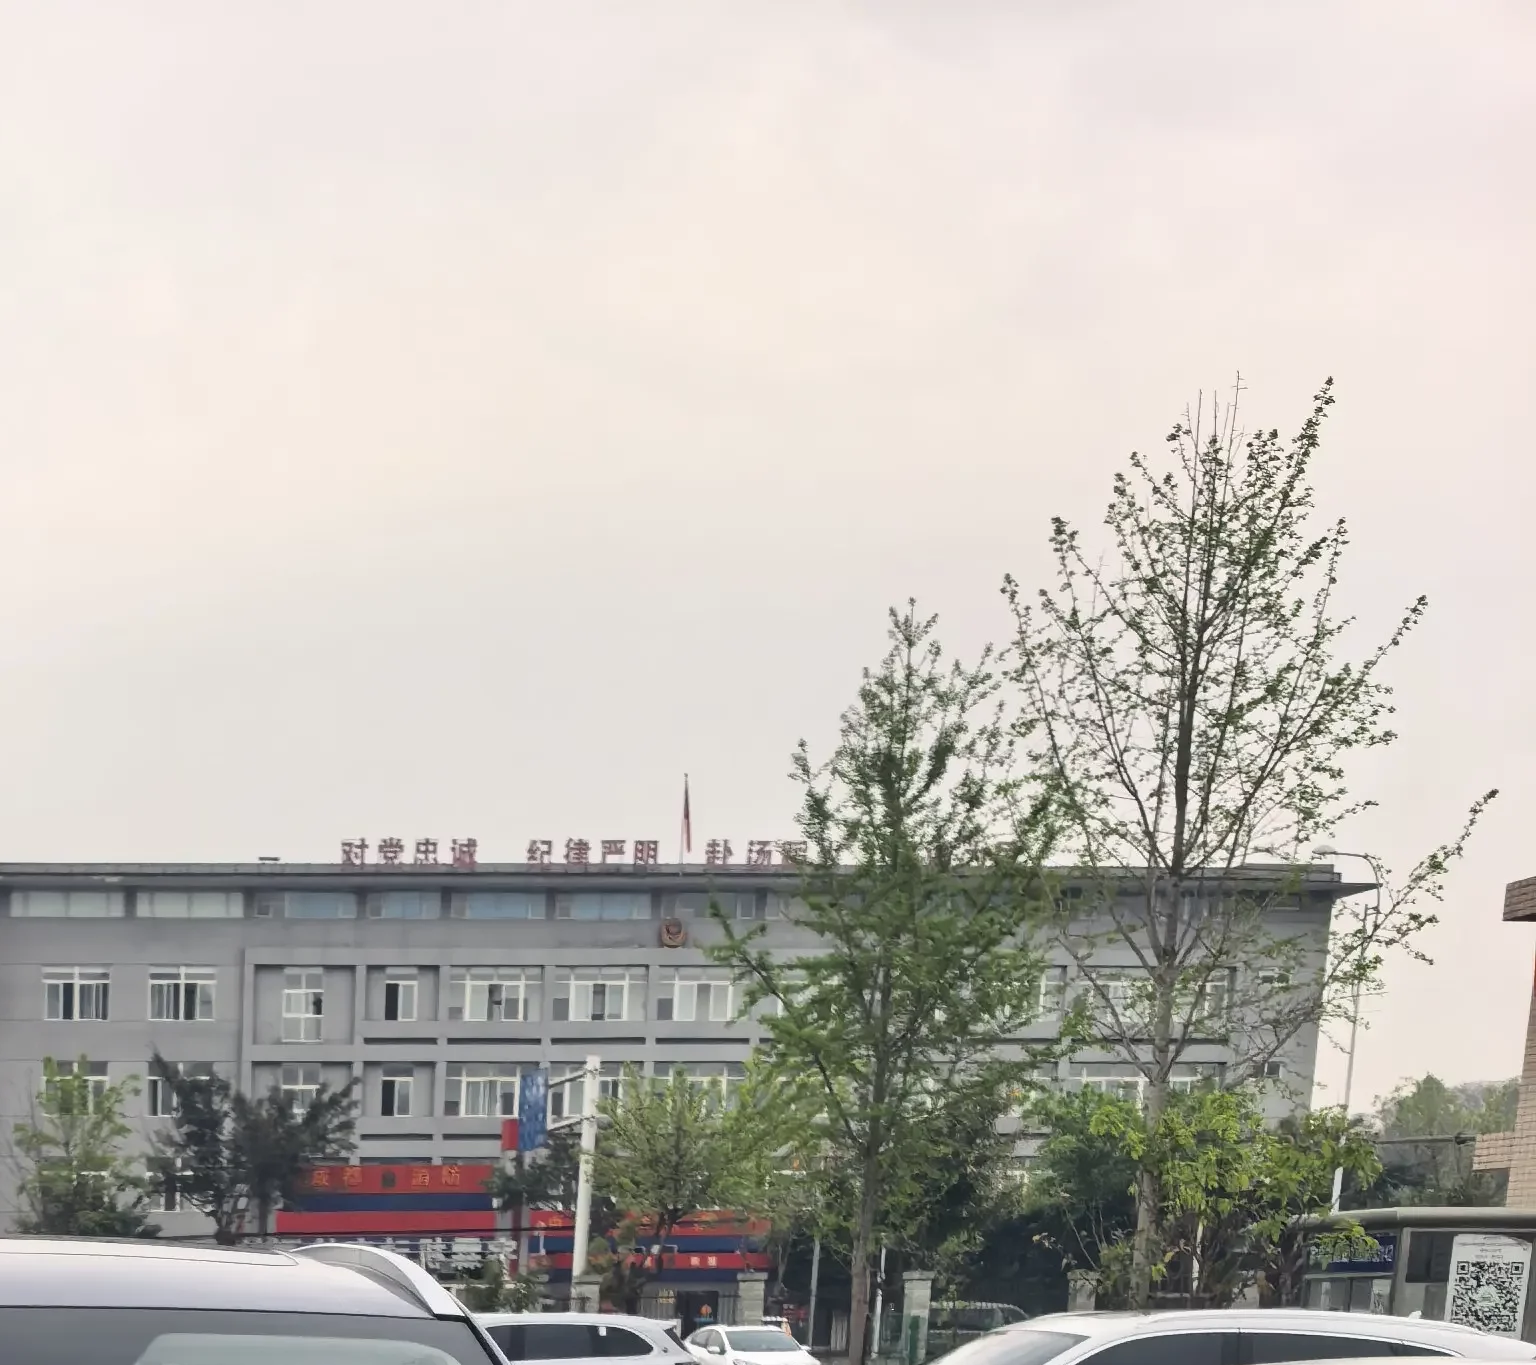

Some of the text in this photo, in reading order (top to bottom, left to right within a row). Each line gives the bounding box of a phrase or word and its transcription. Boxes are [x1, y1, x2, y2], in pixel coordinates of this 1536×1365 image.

[341, 837, 477, 868] 对党忠诚
[527, 837, 658, 866] 纪律严明
